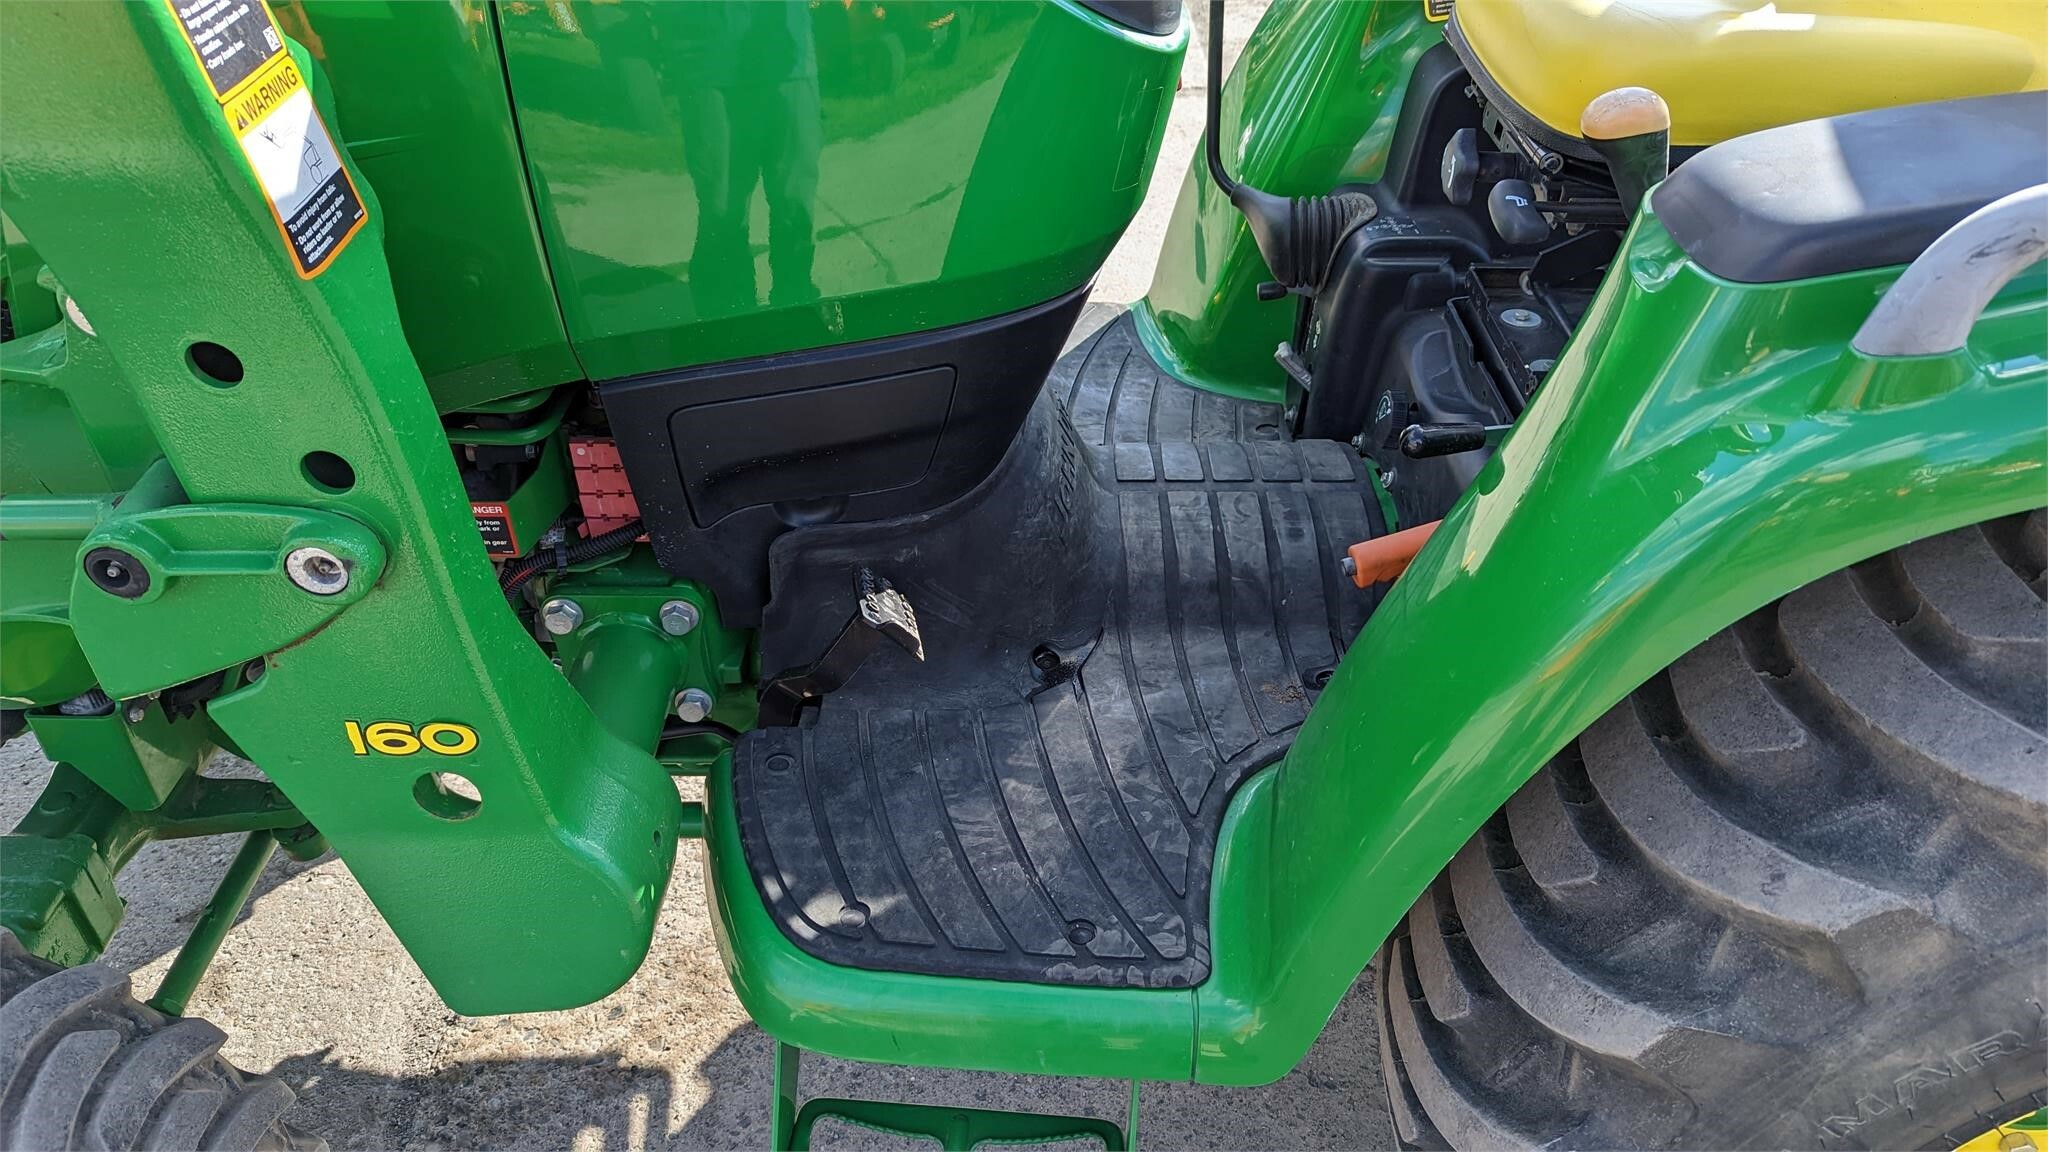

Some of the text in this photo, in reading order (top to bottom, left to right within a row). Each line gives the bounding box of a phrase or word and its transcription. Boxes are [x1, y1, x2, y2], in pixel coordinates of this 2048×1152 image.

[194, 28, 215, 45] Handle
[207, 55, 224, 69] Carry
[241, 65, 298, 122] WARNING
[288, 223, 298, 233] To
[296, 211, 309, 228] avoid
[305, 201, 320, 217] injury
[317, 192, 328, 206] from
[298, 193, 345, 245] Do not work from or allow
[303, 209, 343, 254] riders on loader or its
[472, 506, 503, 514] NGER
[344, 720, 479, 756] 160
